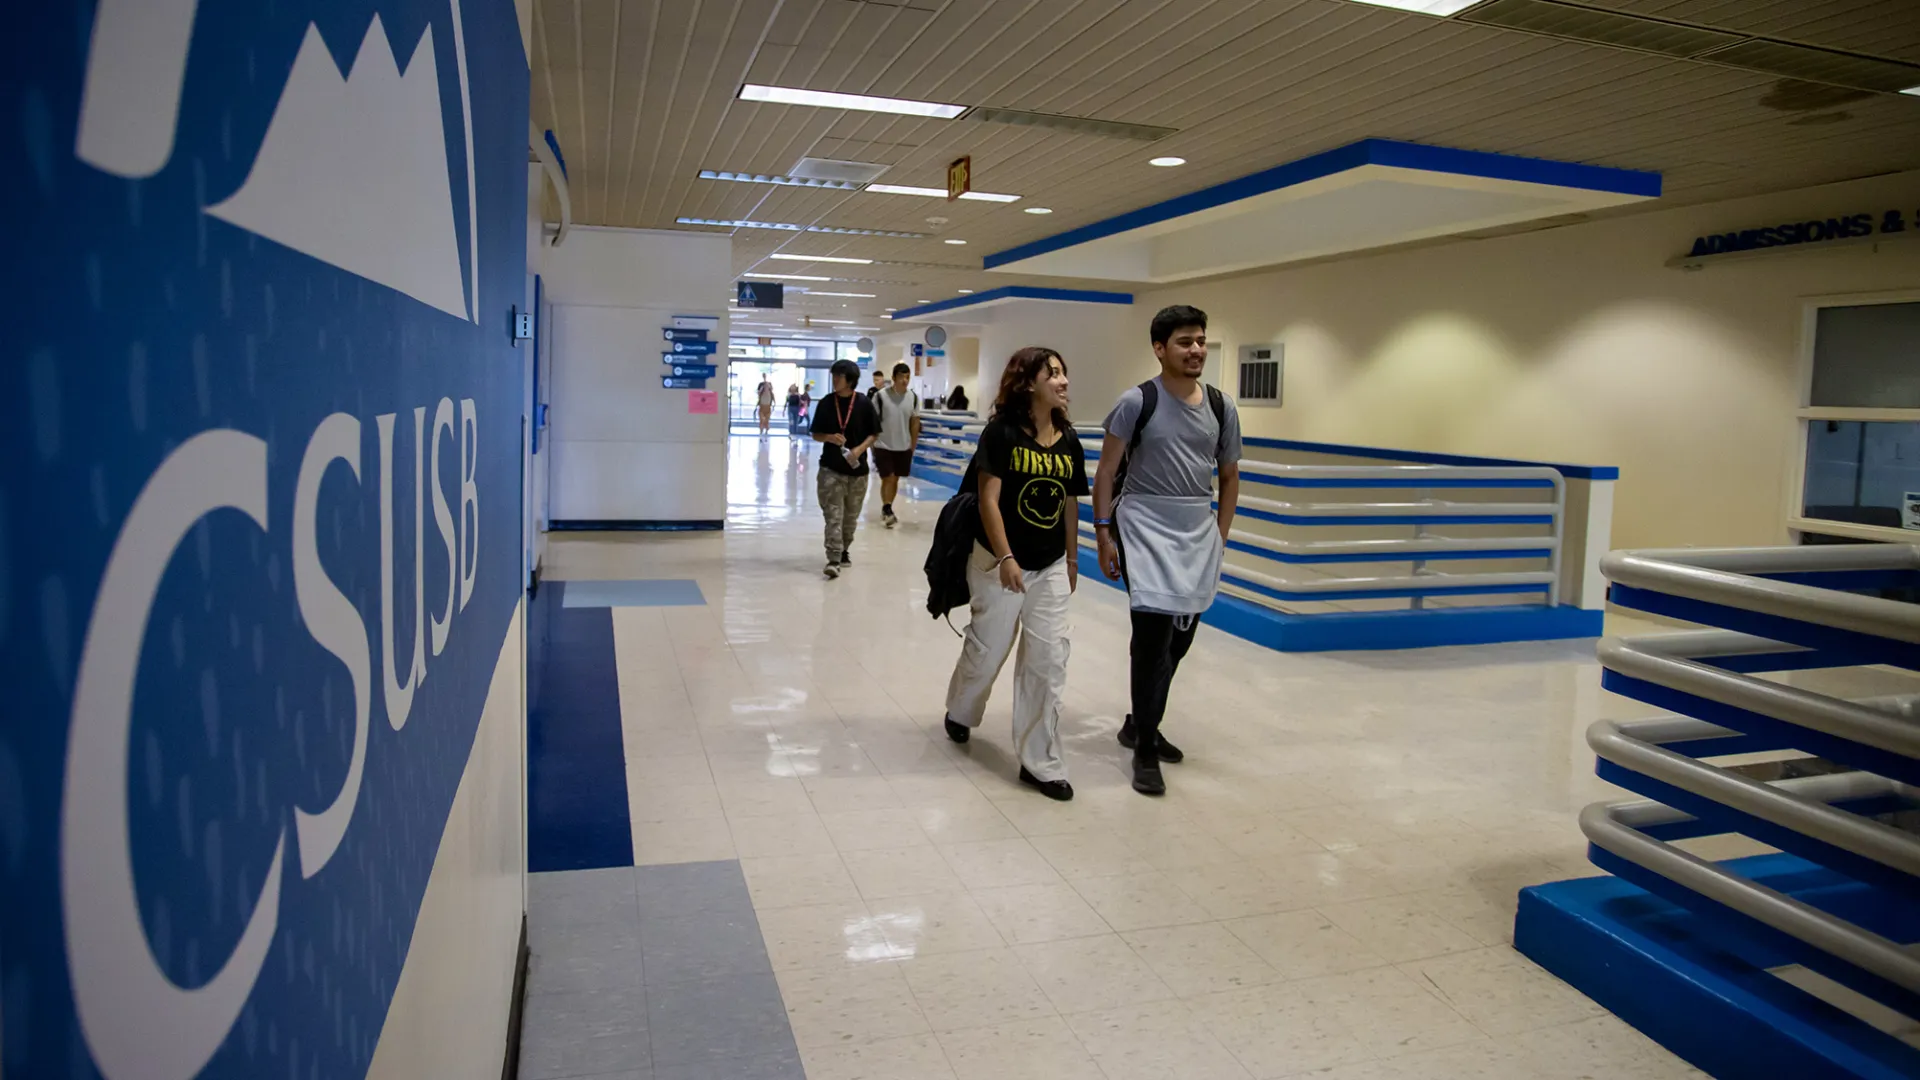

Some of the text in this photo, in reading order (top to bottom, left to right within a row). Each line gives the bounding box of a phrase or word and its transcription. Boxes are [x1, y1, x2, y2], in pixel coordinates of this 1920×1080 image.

[1690, 213, 1873, 256] ADMISSIONS
[1880, 210, 1905, 233] &
[1009, 446, 1073, 479] NIRVAN
[60, 396, 478, 1080] CSUSB
